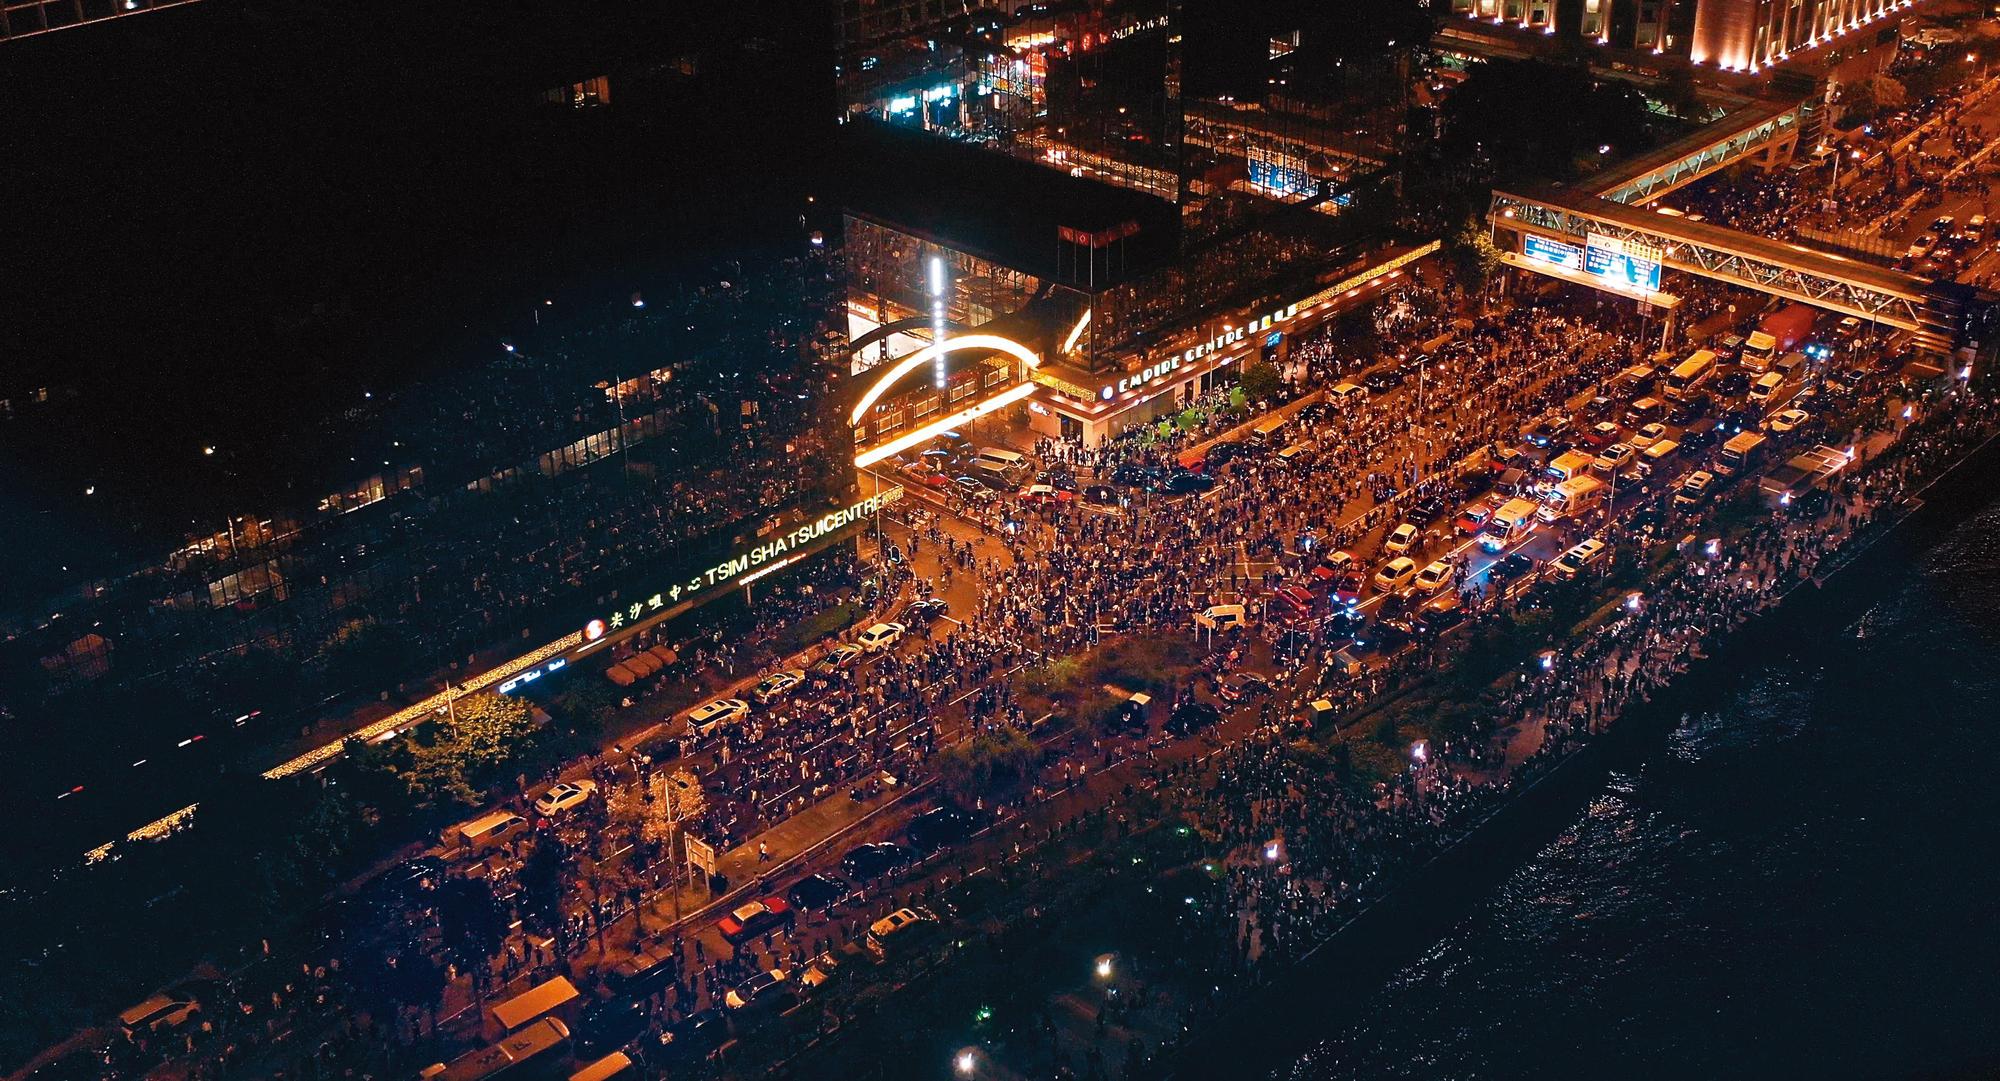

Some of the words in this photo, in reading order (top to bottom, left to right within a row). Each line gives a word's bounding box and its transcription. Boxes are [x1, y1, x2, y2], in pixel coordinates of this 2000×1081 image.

[1118, 355, 1180, 393] EMPIRE
[1185, 327, 1244, 362] CENTRE
[705, 554, 748, 585] TSIM
[750, 538, 789, 566] SHA
[609, 577, 702, 629] 尖沙咀中心
